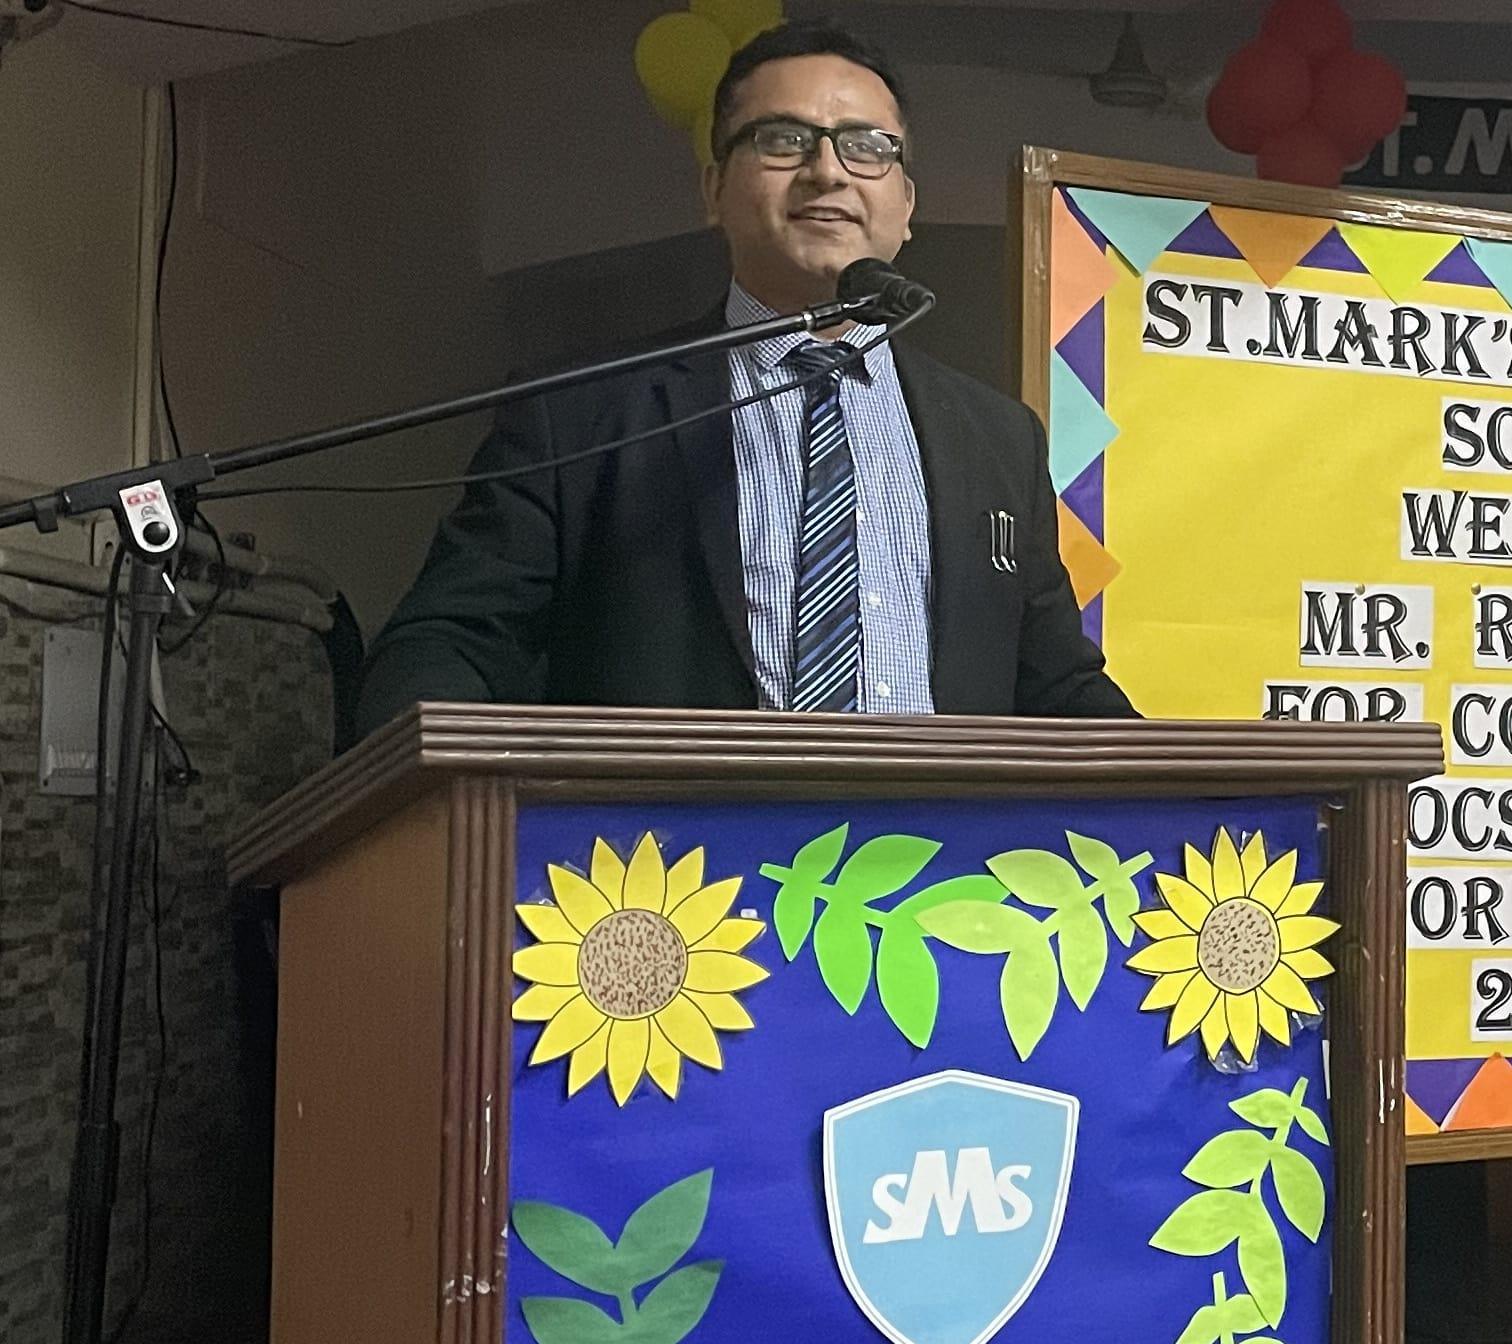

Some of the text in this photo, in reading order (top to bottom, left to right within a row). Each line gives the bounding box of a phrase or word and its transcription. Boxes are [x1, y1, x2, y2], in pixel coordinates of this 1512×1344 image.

[1300, 590, 1430, 664] MR.
[1262, 684, 1407, 722] FOR
[1406, 876, 1510, 945] OR
[862, 1146, 1033, 1244] SMS
